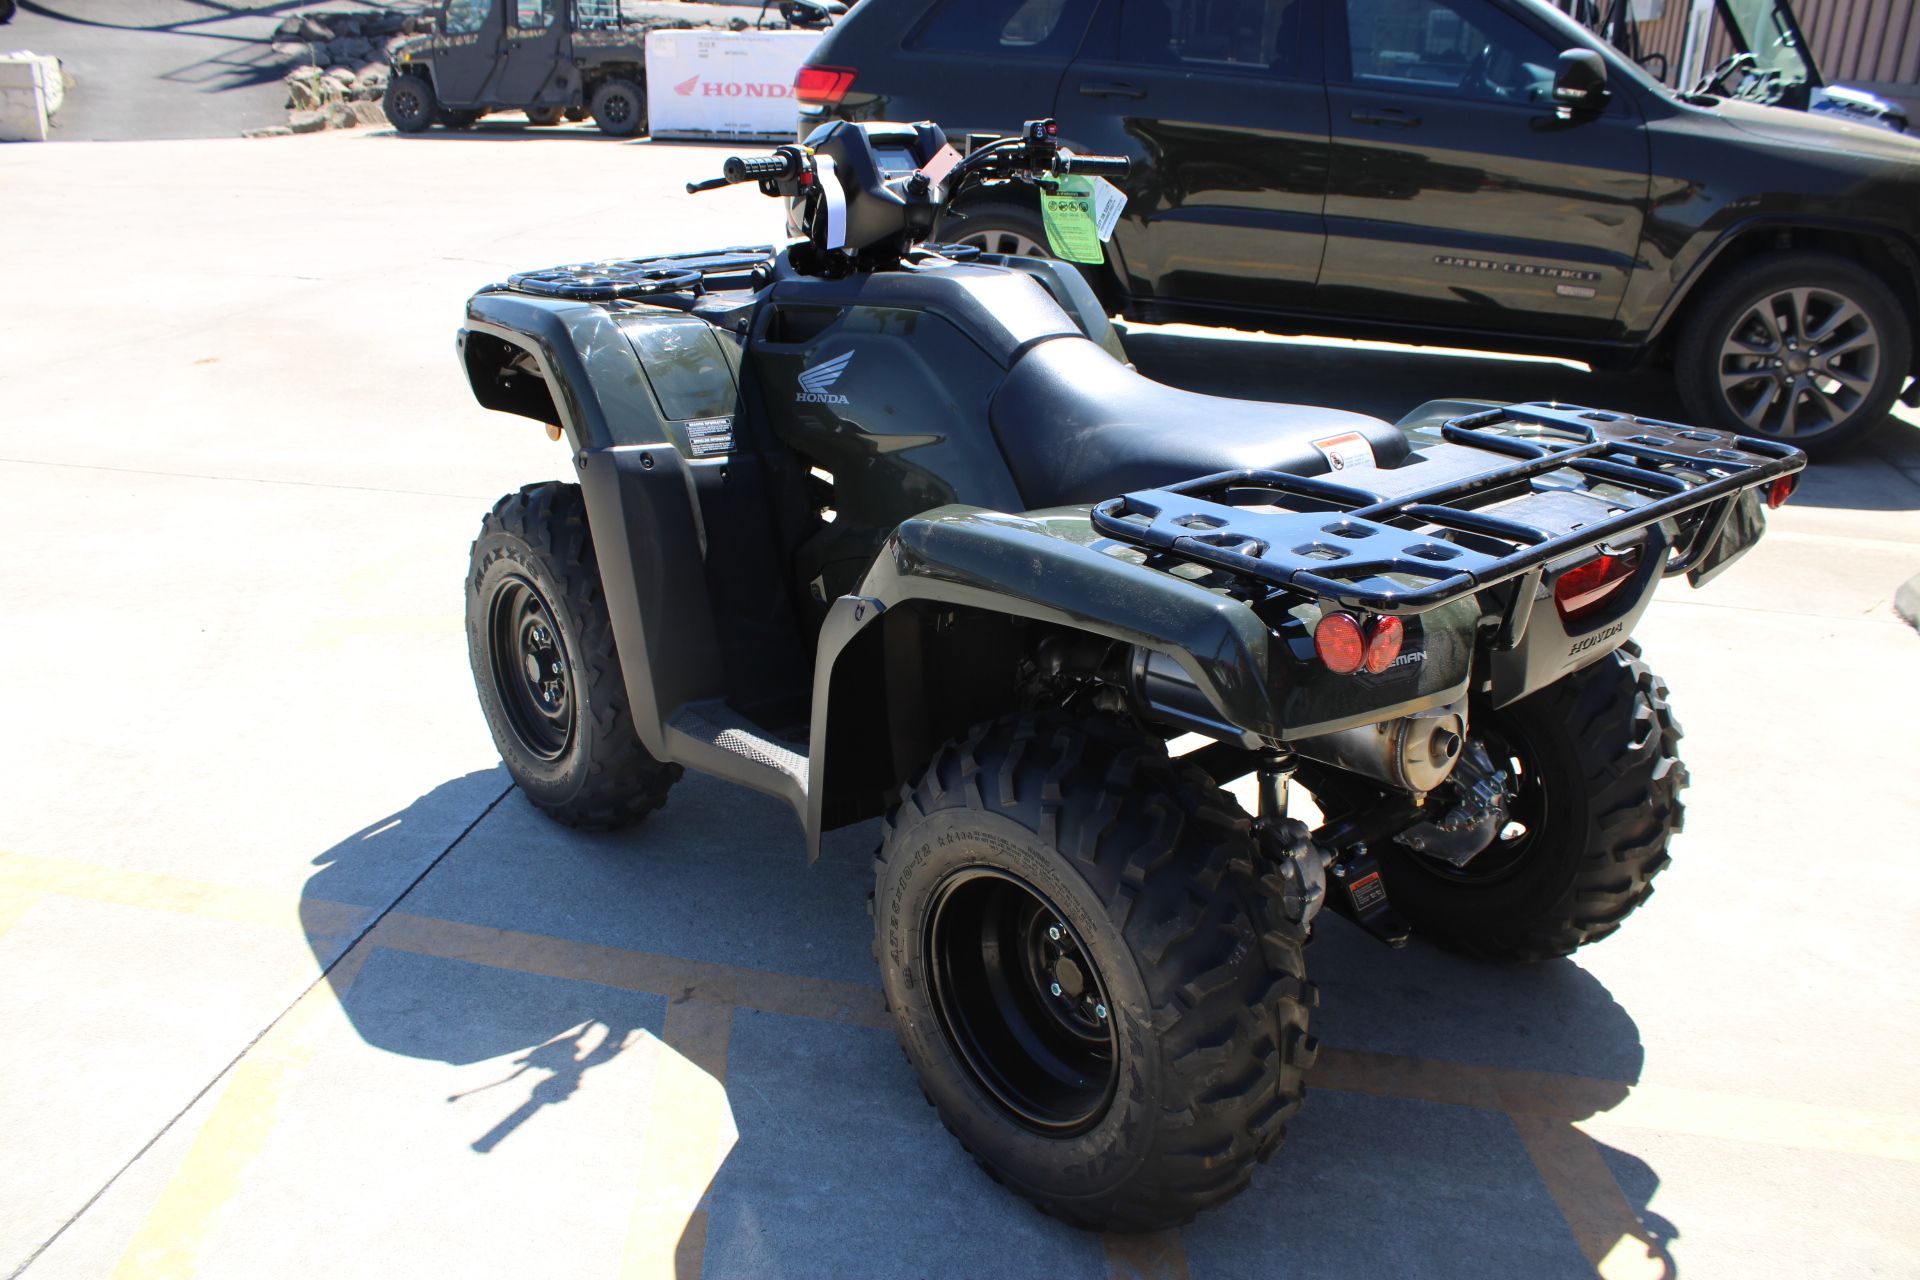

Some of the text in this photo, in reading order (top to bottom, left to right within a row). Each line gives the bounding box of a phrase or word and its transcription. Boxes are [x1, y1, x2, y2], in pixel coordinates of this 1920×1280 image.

[795, 392, 850, 405] HONDA
[474, 546, 540, 596] MAXXIS
[1568, 622, 1623, 657] HONDA
